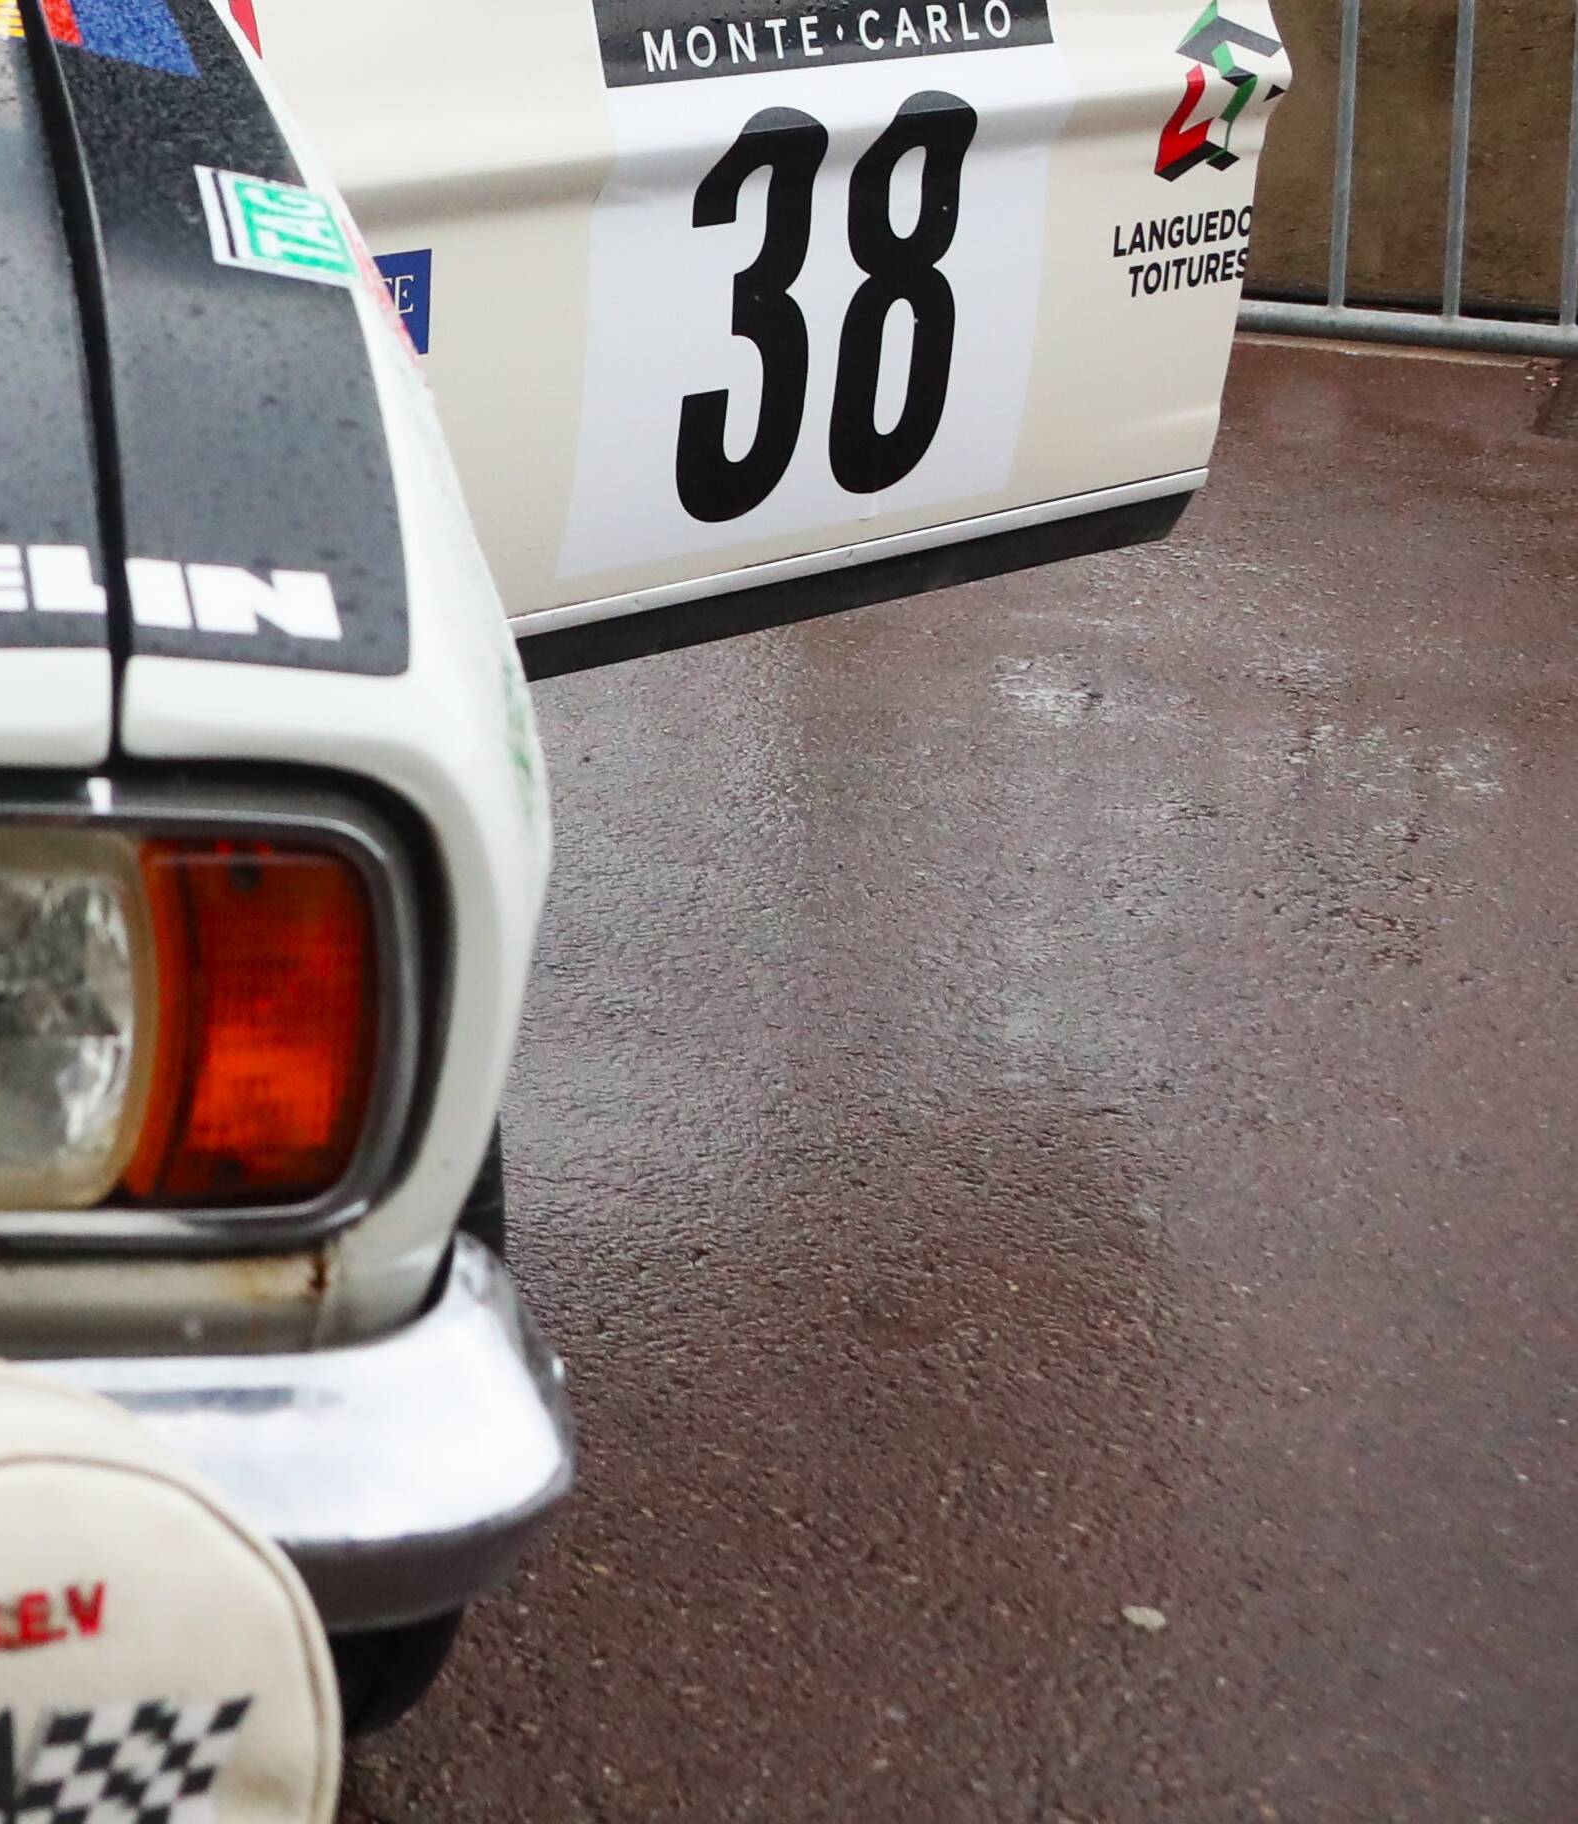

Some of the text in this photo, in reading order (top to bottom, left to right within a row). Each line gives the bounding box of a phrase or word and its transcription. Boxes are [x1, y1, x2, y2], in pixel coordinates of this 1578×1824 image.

[642, 13, 819, 73] MONTE
[1128, 247, 1250, 299] TOITURES
[674, 89, 979, 524] 38
